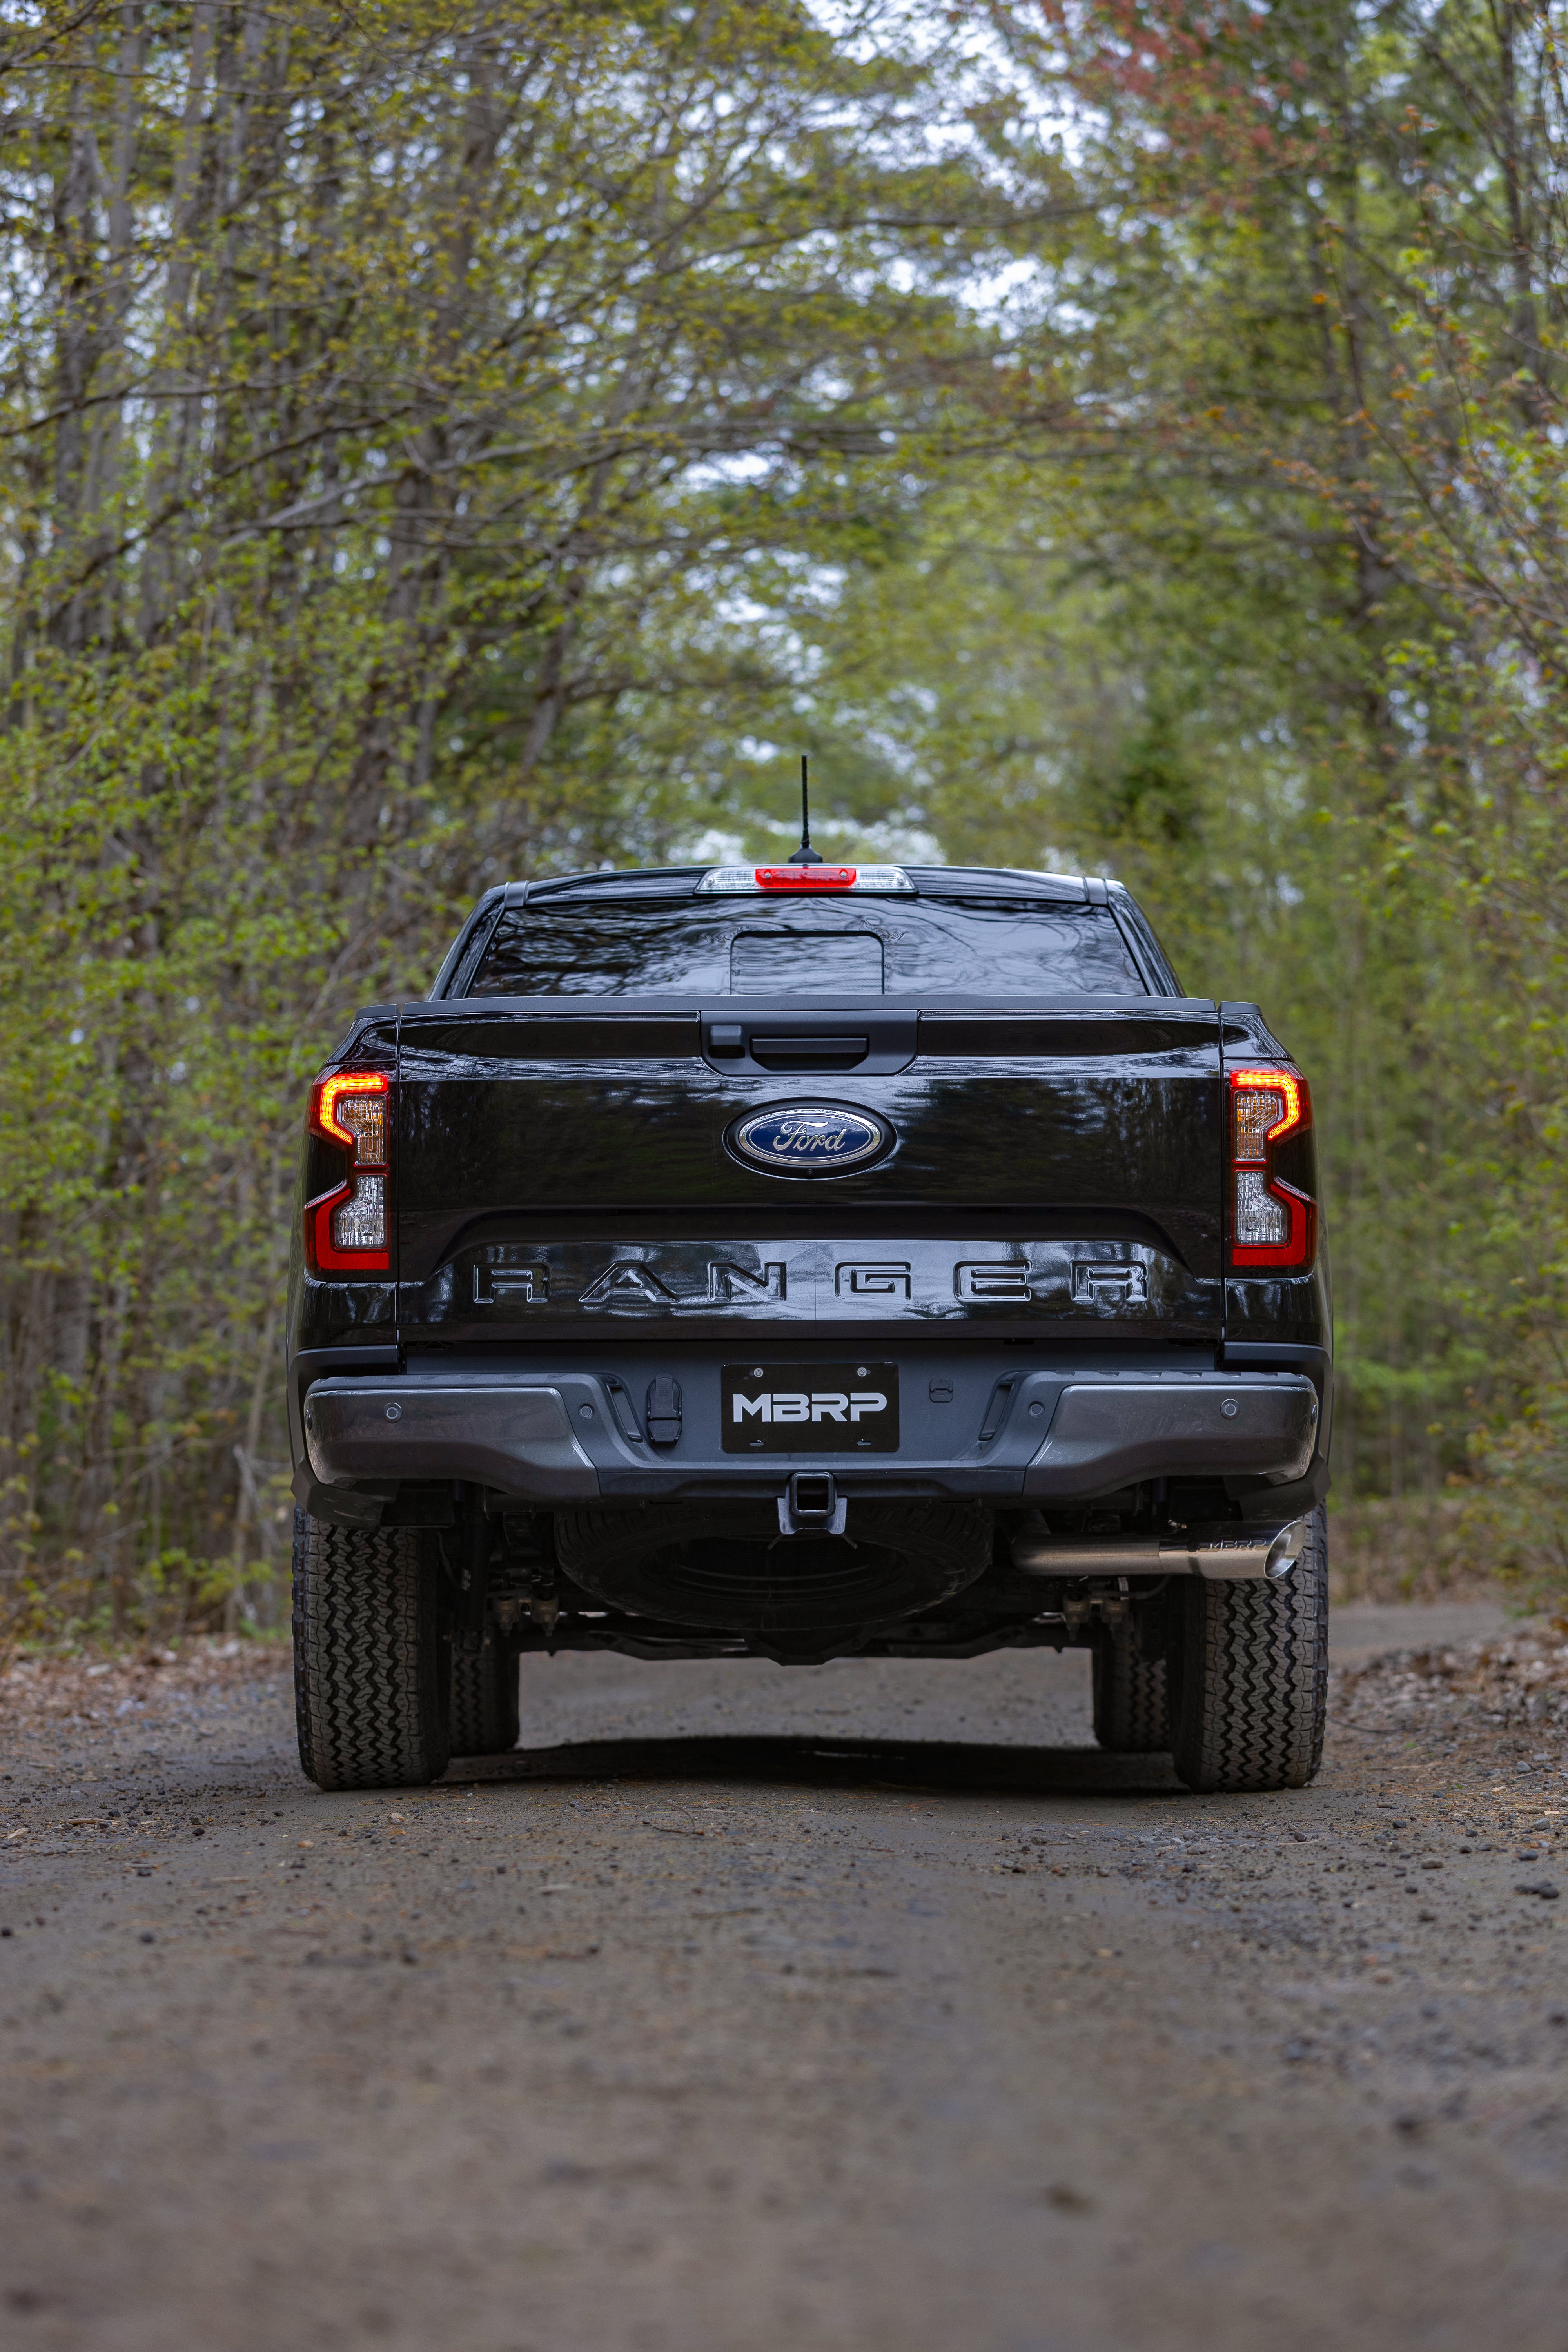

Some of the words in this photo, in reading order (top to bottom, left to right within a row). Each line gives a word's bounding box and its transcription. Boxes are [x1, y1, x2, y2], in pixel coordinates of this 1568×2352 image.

[773, 1120, 847, 1151] Ford
[473, 1259, 1148, 1303] RANGER
[733, 1392, 887, 1422] MBRP
[1208, 1537, 1266, 1551] MBRP
